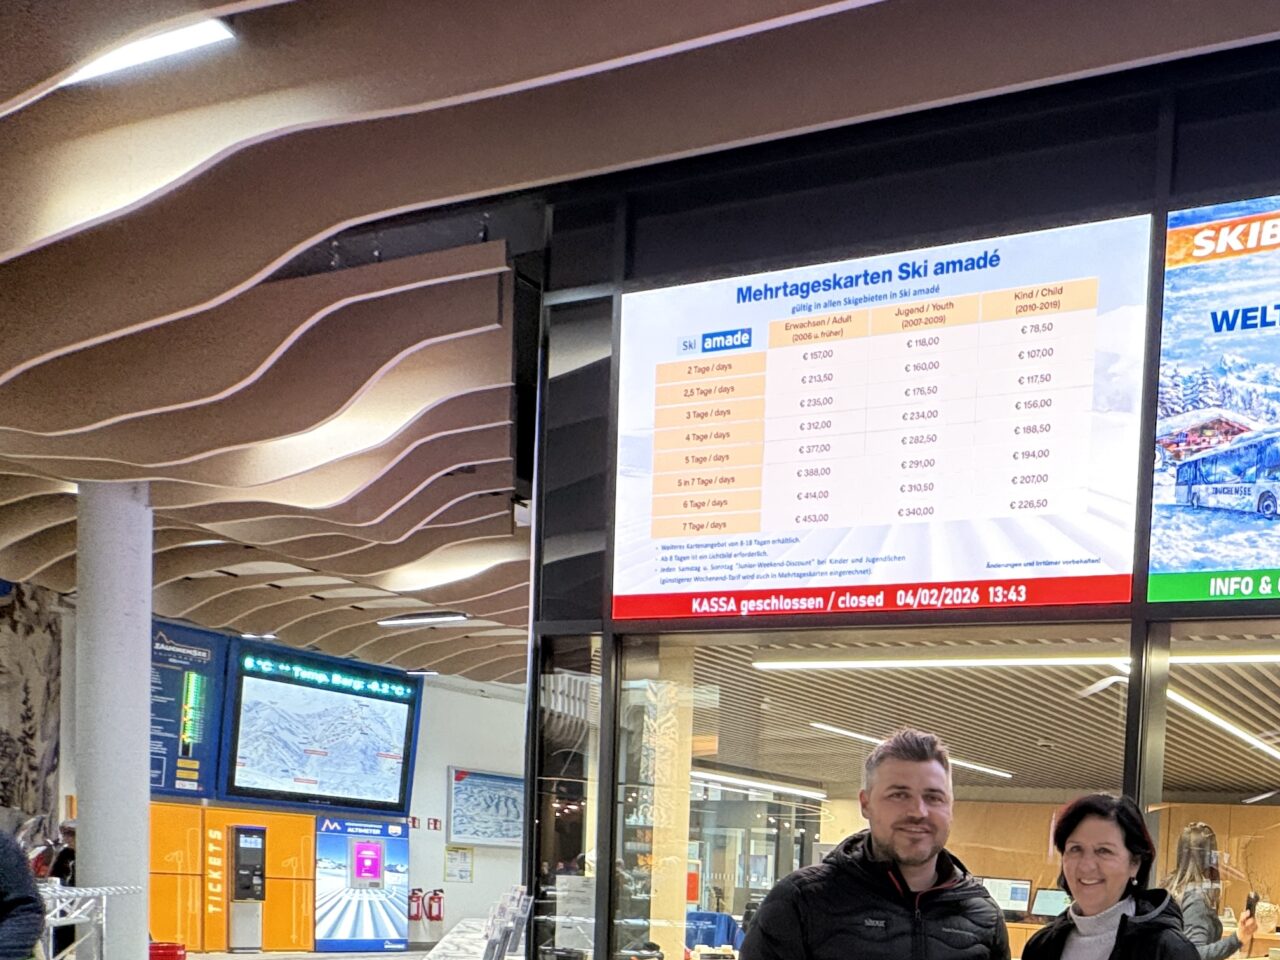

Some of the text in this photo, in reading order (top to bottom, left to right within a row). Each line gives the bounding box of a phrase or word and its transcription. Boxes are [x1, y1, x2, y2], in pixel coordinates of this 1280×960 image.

[736, 249, 1000, 304] Mehrtageskarten Ski amadé
[791, 304, 812, 314] gültig
[823, 300, 841, 308] allen
[843, 294, 887, 306] Skigebieten
[890, 291, 897, 299] in
[899, 289, 910, 298] Ski
[913, 284, 940, 296] amadé
[1014, 290, 1033, 300] Kind
[1041, 286, 1063, 297] Child
[895, 305, 924, 317] Jugend
[932, 301, 954, 311] Youth
[1016, 300, 1060, 315] (2010-2019)
[785, 320, 825, 331] Erwachsen
[832, 315, 852, 324] Adult
[902, 315, 946, 330] (2007-2009)
[1021, 322, 1053, 334] € 78,50
[792, 333, 812, 343] (2006
[821, 328, 843, 337] früher)
[683, 340, 696, 350] Ski
[907, 336, 940, 348] € 118,00
[810, 349, 833, 359] 157,00
[688, 366, 692, 374] 2
[694, 366, 710, 374] Tage
[716, 363, 732, 372] days
[1018, 373, 1051, 385] € 117,50
[913, 386, 938, 395] 176,50
[807, 397, 833, 407] 235,00
[1015, 398, 1052, 410] € 156,00
[686, 411, 691, 419] 3
[693, 411, 708, 420] Tage
[715, 409, 731, 417] days
[910, 410, 938, 420] 234,00
[800, 420, 831, 431] € 312,00
[692, 433, 708, 442] Tage
[714, 432, 730, 440] days
[1010, 499, 1048, 509] € 226,50
[898, 506, 934, 517] € 340,00
[802, 514, 829, 522] 453,00
[688, 522, 704, 531] Tage
[1209, 576, 1254, 596] INFO
[1258, 576, 1272, 595] &
[692, 585, 1026, 615] KASSA geschlossen / closed 04/02/2026 13:43
[346, 827, 381, 836] ALTIMETER
[208, 829, 223, 914] TICKETS
